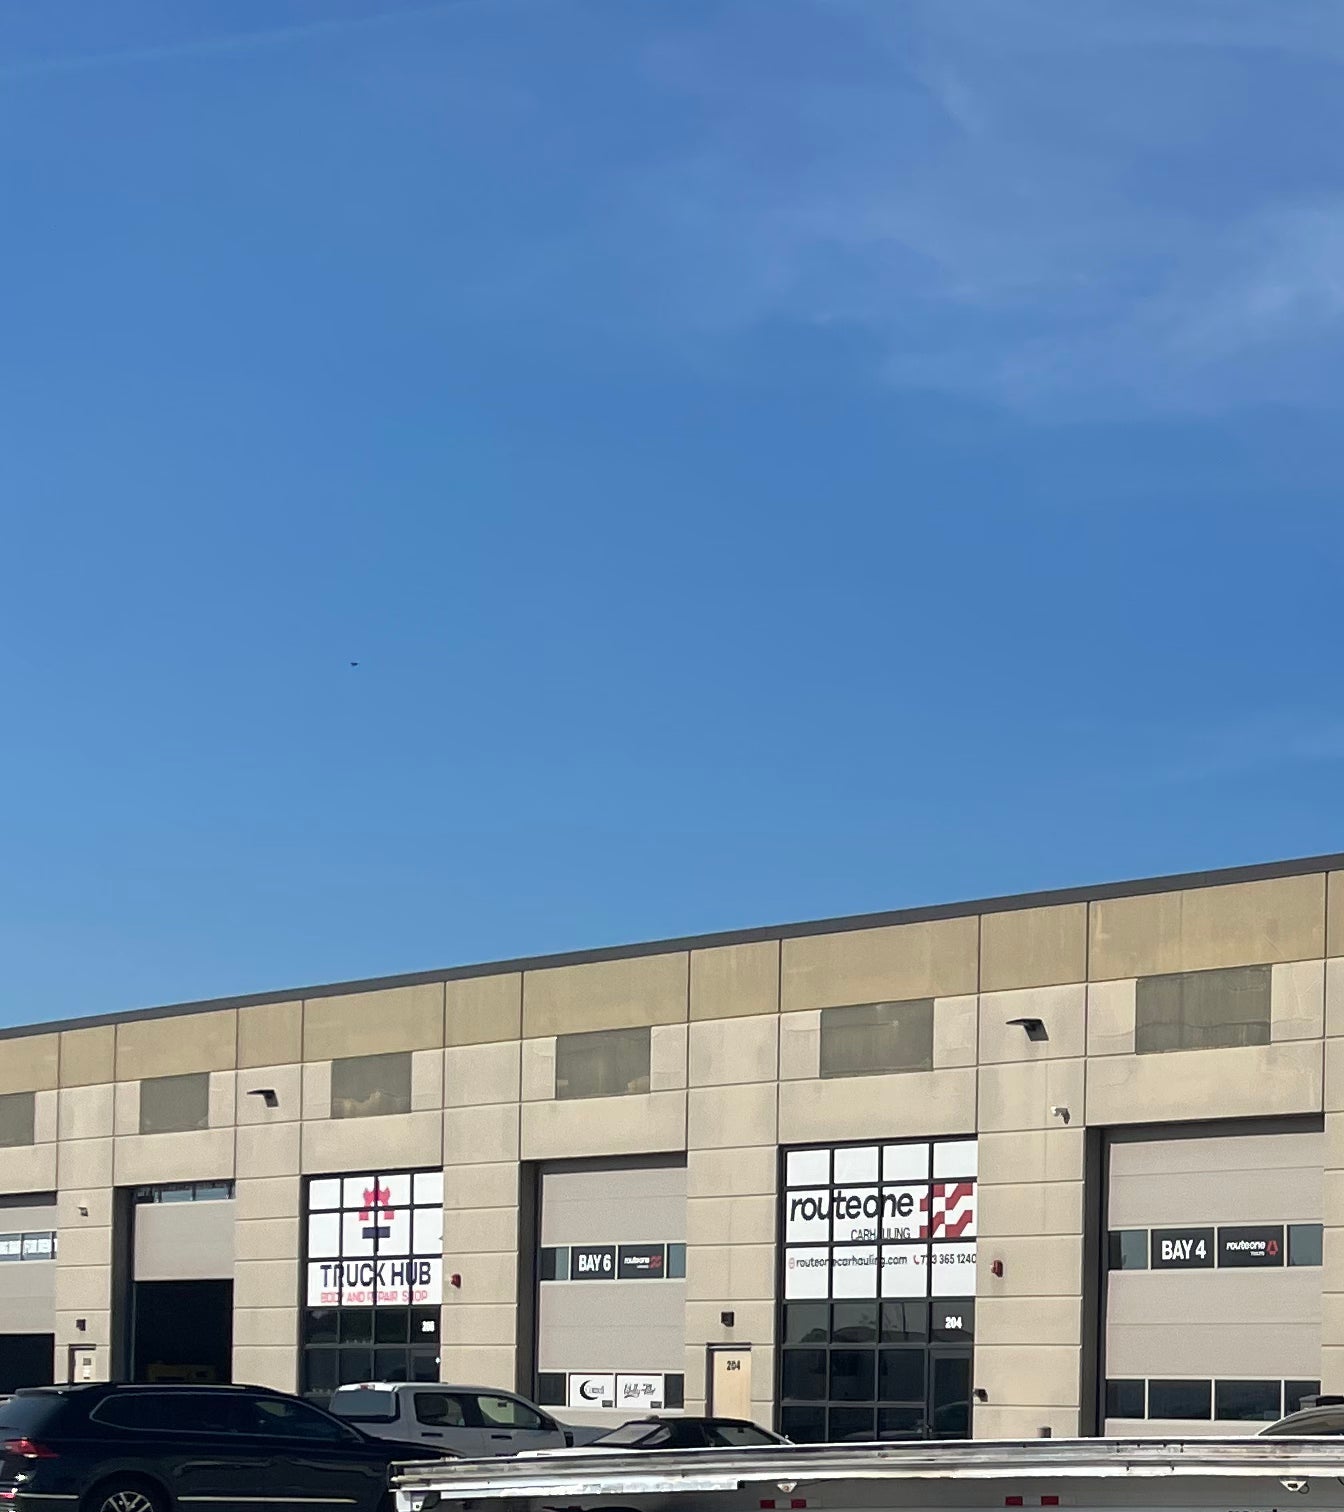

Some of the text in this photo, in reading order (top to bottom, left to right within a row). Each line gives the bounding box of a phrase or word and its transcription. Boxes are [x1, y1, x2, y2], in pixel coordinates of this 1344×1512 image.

[790, 1190, 914, 1221] routeone
[850, 1227, 911, 1241] CARHULING
[1161, 1240, 1207, 1260] BAY 4
[578, 1254, 612, 1272] BAY 6
[320, 1261, 431, 1287] TRUCK HUB
[320, 1291, 343, 1303] BOD
[402, 1290, 428, 1302] SOP
[945, 1316, 963, 1329] 204
